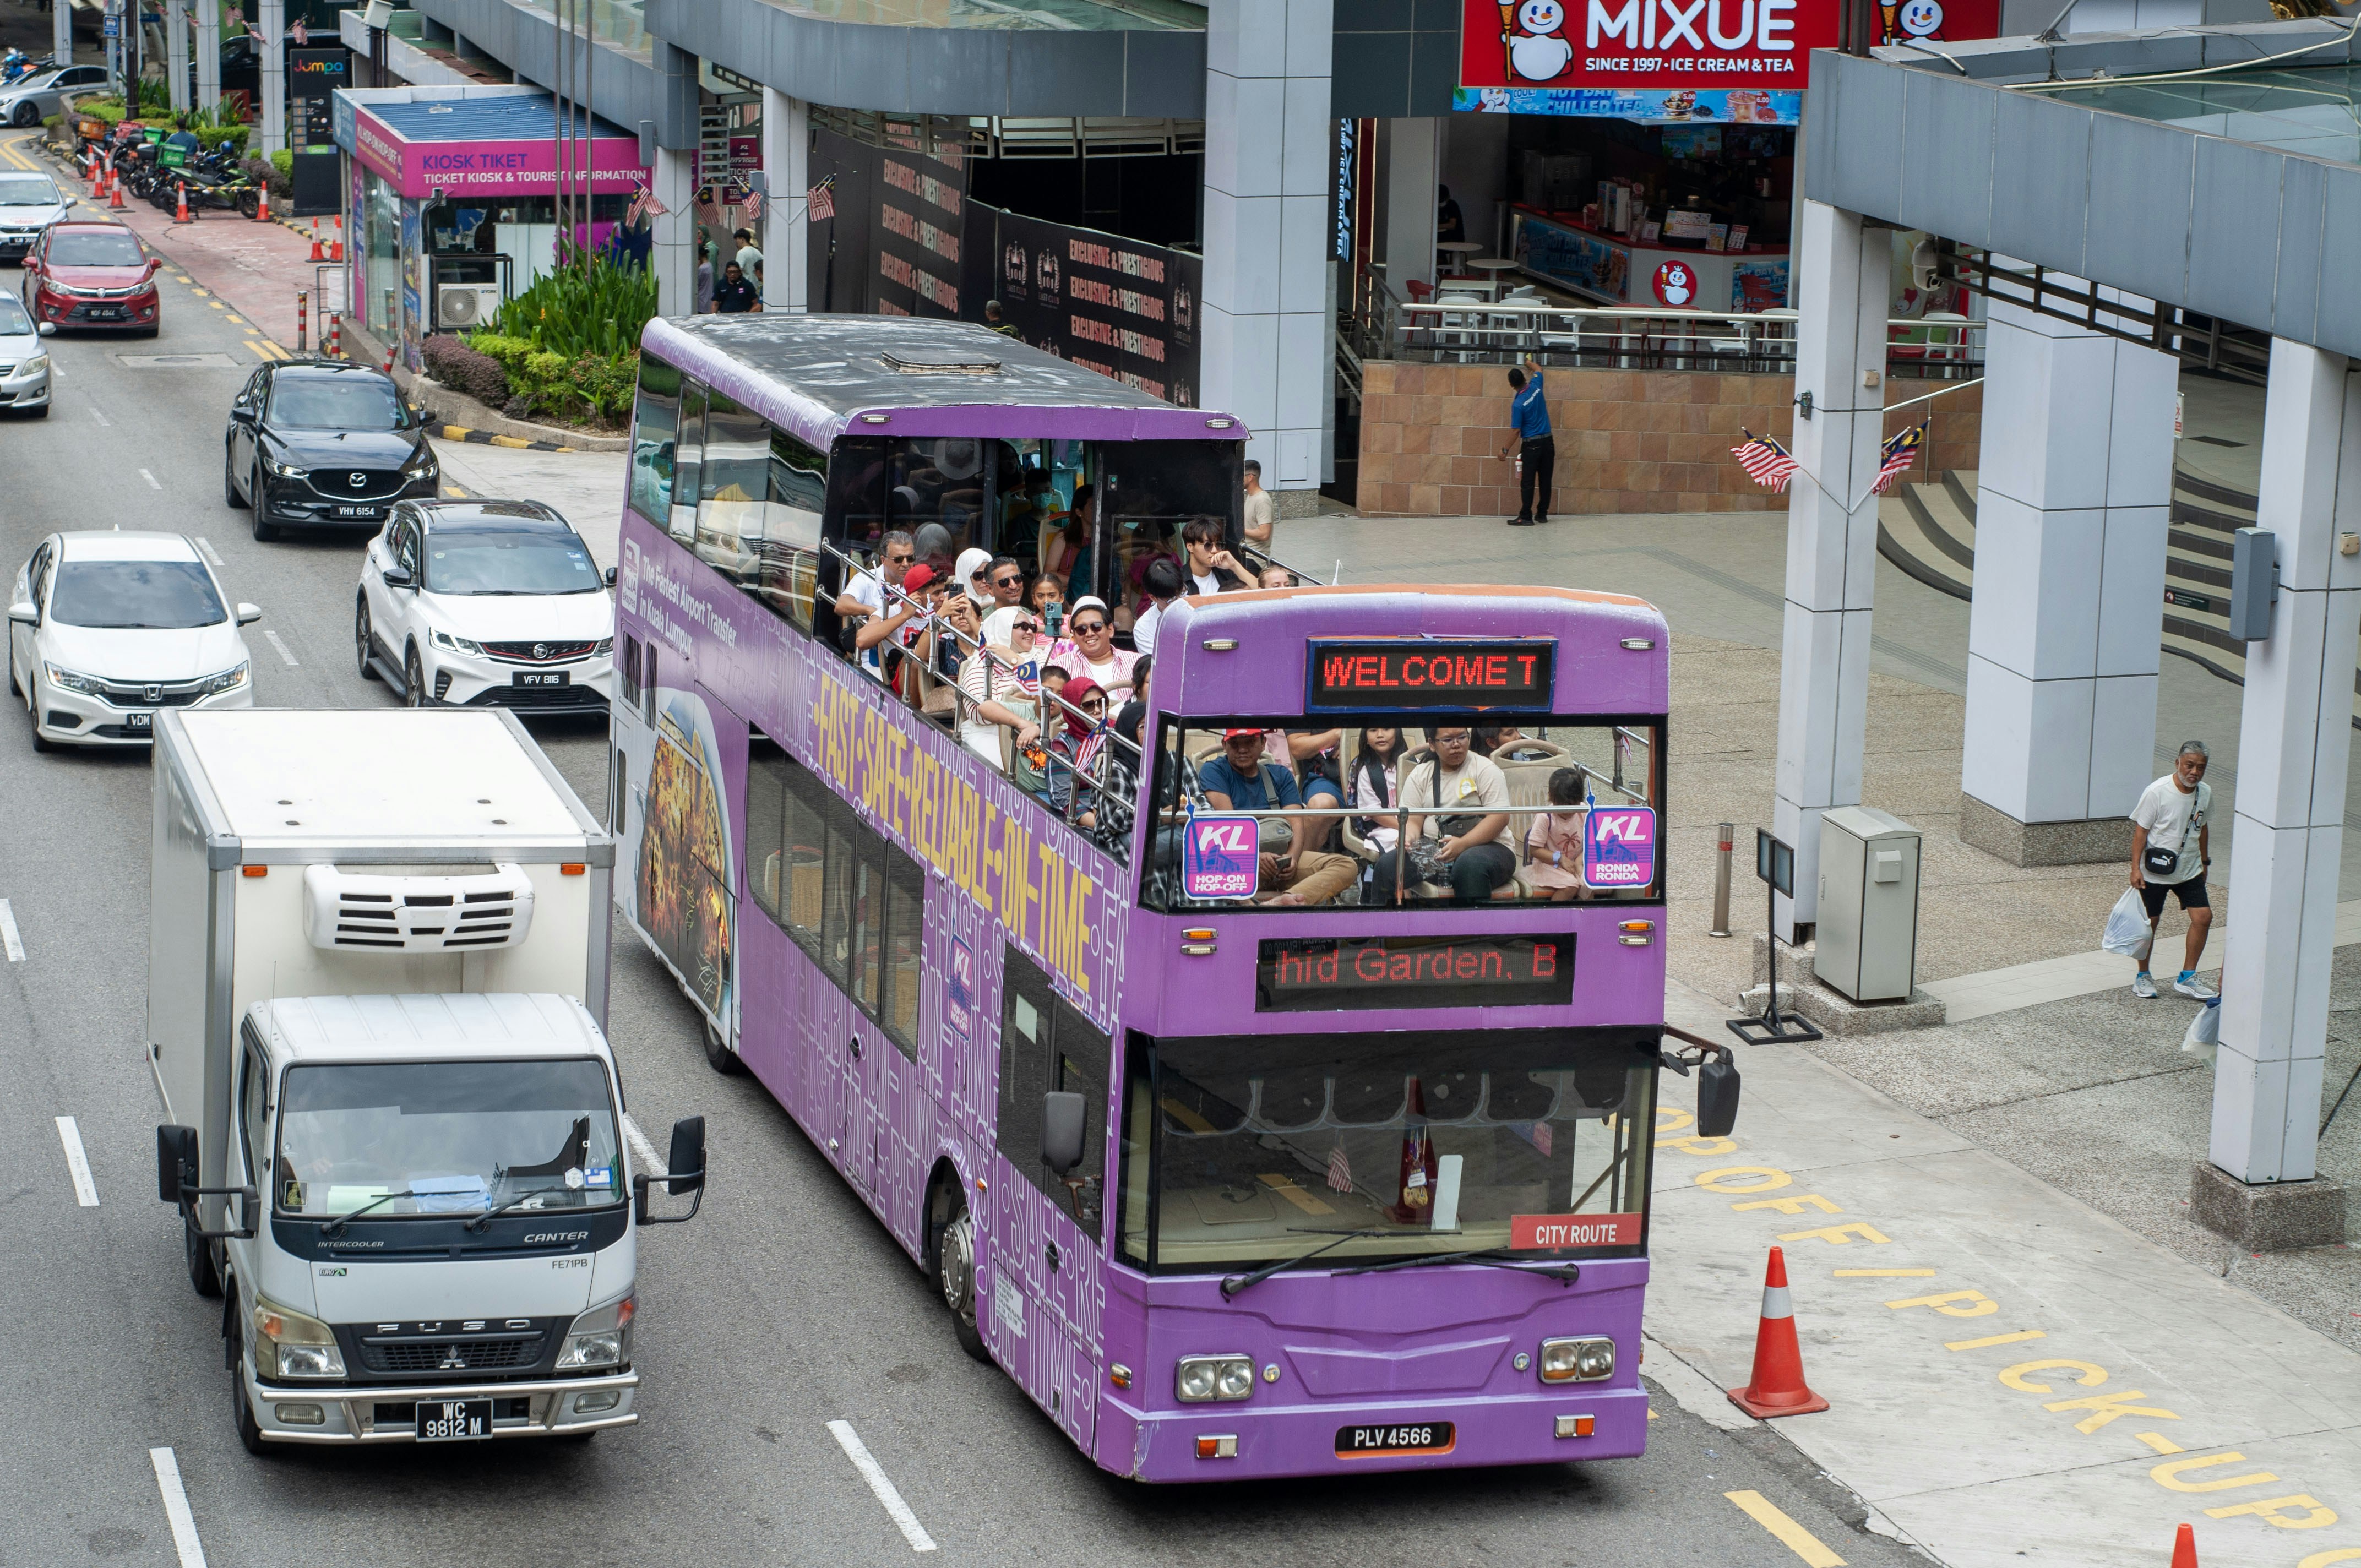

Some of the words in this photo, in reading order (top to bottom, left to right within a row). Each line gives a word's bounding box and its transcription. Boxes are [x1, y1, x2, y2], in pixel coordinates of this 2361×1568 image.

[1586, 0, 1797, 50] MIXUE
[294, 59, 344, 75] Jumpa
[1586, 58, 1629, 72] SINCE
[1633, 58, 1662, 72] 1997
[1671, 58, 1693, 72] ICE
[1698, 58, 1749, 72] CREAM
[1751, 58, 1762, 72] &
[1764, 58, 1794, 72] TEA
[1547, 101, 1611, 114] CHILLED
[1612, 100, 1644, 114] TEA
[423, 154, 474, 170] KIOSK
[480, 154, 528, 168] TIKET
[424, 173, 465, 184] TICKET
[467, 172, 503, 183] KIOSK
[505, 172, 514, 182] &
[1070, 239, 1110, 268] EXCLUSIVE
[1112, 252, 1118, 270] &
[1118, 251, 1165, 284] PRESTIGIOUS
[1043, 276, 1053, 290] 101
[1070, 276, 1111, 306] EXCLUSIVE
[1112, 290, 1118, 308] &
[1119, 288, 1165, 322] PRESTIGIOUS
[1071, 315, 1111, 346] EXCLUSIVE
[1113, 329, 1119, 348] &
[1120, 329, 1165, 363] PRESTIGIOUS
[339, 507, 355, 515] VHW
[356, 507, 375, 515] 6154
[643, 555, 654, 586] The
[655, 564, 680, 606] Fastest
[679, 585, 705, 625] Airport
[707, 602, 737, 650] Transfer
[639, 590, 646, 619] in
[646, 597, 665, 634] Kuala
[665, 612, 693, 655] Lumpur
[524, 675, 541, 684] VFV
[543, 675, 559, 684] 8116
[1324, 656, 1509, 687] WELCOME
[1517, 656, 1536, 685] T
[130, 715, 150, 726] VDM
[818, 673, 859, 793] FAST
[862, 707, 906, 834] SAFE
[910, 744, 996, 913] RELIABLE
[1000, 816, 1094, 993] ON-TIME
[1596, 816, 1646, 841] KL
[1199, 825, 1249, 851] KL
[1596, 863, 1639, 872] RONDA
[2151, 857, 2168, 866] PUMA
[1196, 874, 1246, 884] HOP-ON
[1596, 872, 1639, 881] RONDA
[1195, 882, 1248, 892] HOP-OFF
[954, 946, 970, 987] KL
[1275, 949, 1339, 984] hid
[1532, 944, 1557, 977] B
[951, 1001, 968, 1022] HOP-ON
[951, 1011, 968, 1032] HOP-OFF
[524, 1231, 589, 1243] CANTER
[1536, 1225, 1566, 1245] CITY
[1570, 1224, 1618, 1244] ROUTE
[552, 1259, 588, 1270] FE71PB
[377, 1319, 531, 1334] FUSO
[443, 1402, 466, 1420] WC
[426, 1419, 466, 1438] 9812
[470, 1417, 482, 1435] M
[1354, 1428, 1385, 1448] PLV
[1388, 1427, 1432, 1446] 4566
